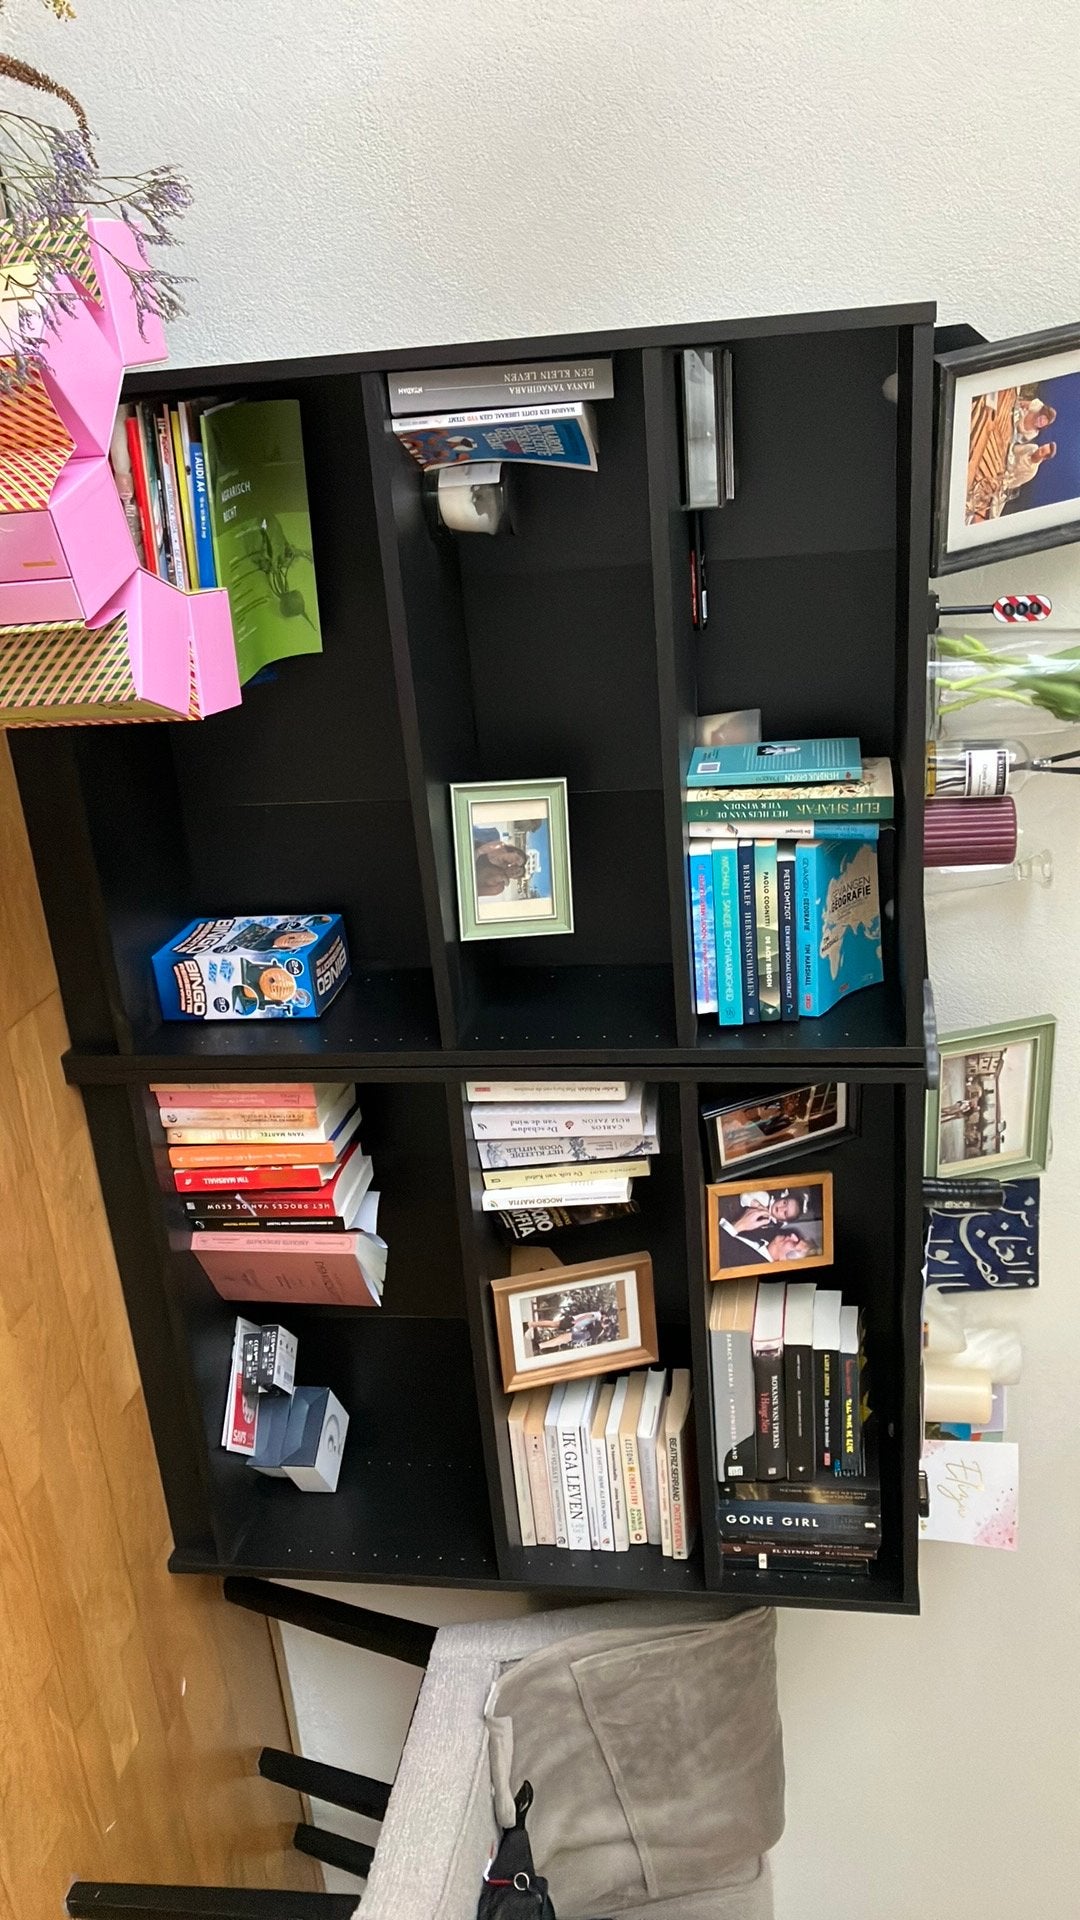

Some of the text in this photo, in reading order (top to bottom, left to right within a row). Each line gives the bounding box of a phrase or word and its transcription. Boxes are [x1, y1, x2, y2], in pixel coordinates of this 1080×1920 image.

[504, 372, 537, 382] LEVEN
[539, 369, 571, 379] KLEIN
[568, 381, 595, 390] HANYA
[195, 457, 205, 480] AUDI
[197, 480, 206, 493] A4
[775, 810, 789, 818] HET
[851, 803, 880, 814] ELIF
[783, 869, 791, 891] PIETER
[783, 891, 792, 921] OMTZIGT
[803, 898, 811, 931] GEOGRAFIE
[743, 864, 755, 997] BERNLEF HERSENSCHIMMEN
[766, 936, 772, 945] DE
[804, 955, 812, 986] MARSHALL
[183, 961, 206, 1016] BINGO
[202, 1175, 249, 1184] TIM MARSHALL
[271, 1202, 309, 1210] PROCES
[535, 1196, 563, 1204] MOCRO
[771, 1375, 779, 1406] ROXANE
[772, 1422, 780, 1449] IPEREN
[624, 1439, 635, 1466] LESSONS
[669, 1437, 679, 1469] BEATRIZ
[561, 1431, 584, 1521] IK GA LEVEN
[671, 1469, 681, 1502] SERRANO
[628, 1473, 639, 1505] CHEMISTRY
[726, 1514, 820, 1528] GONE GIRL
